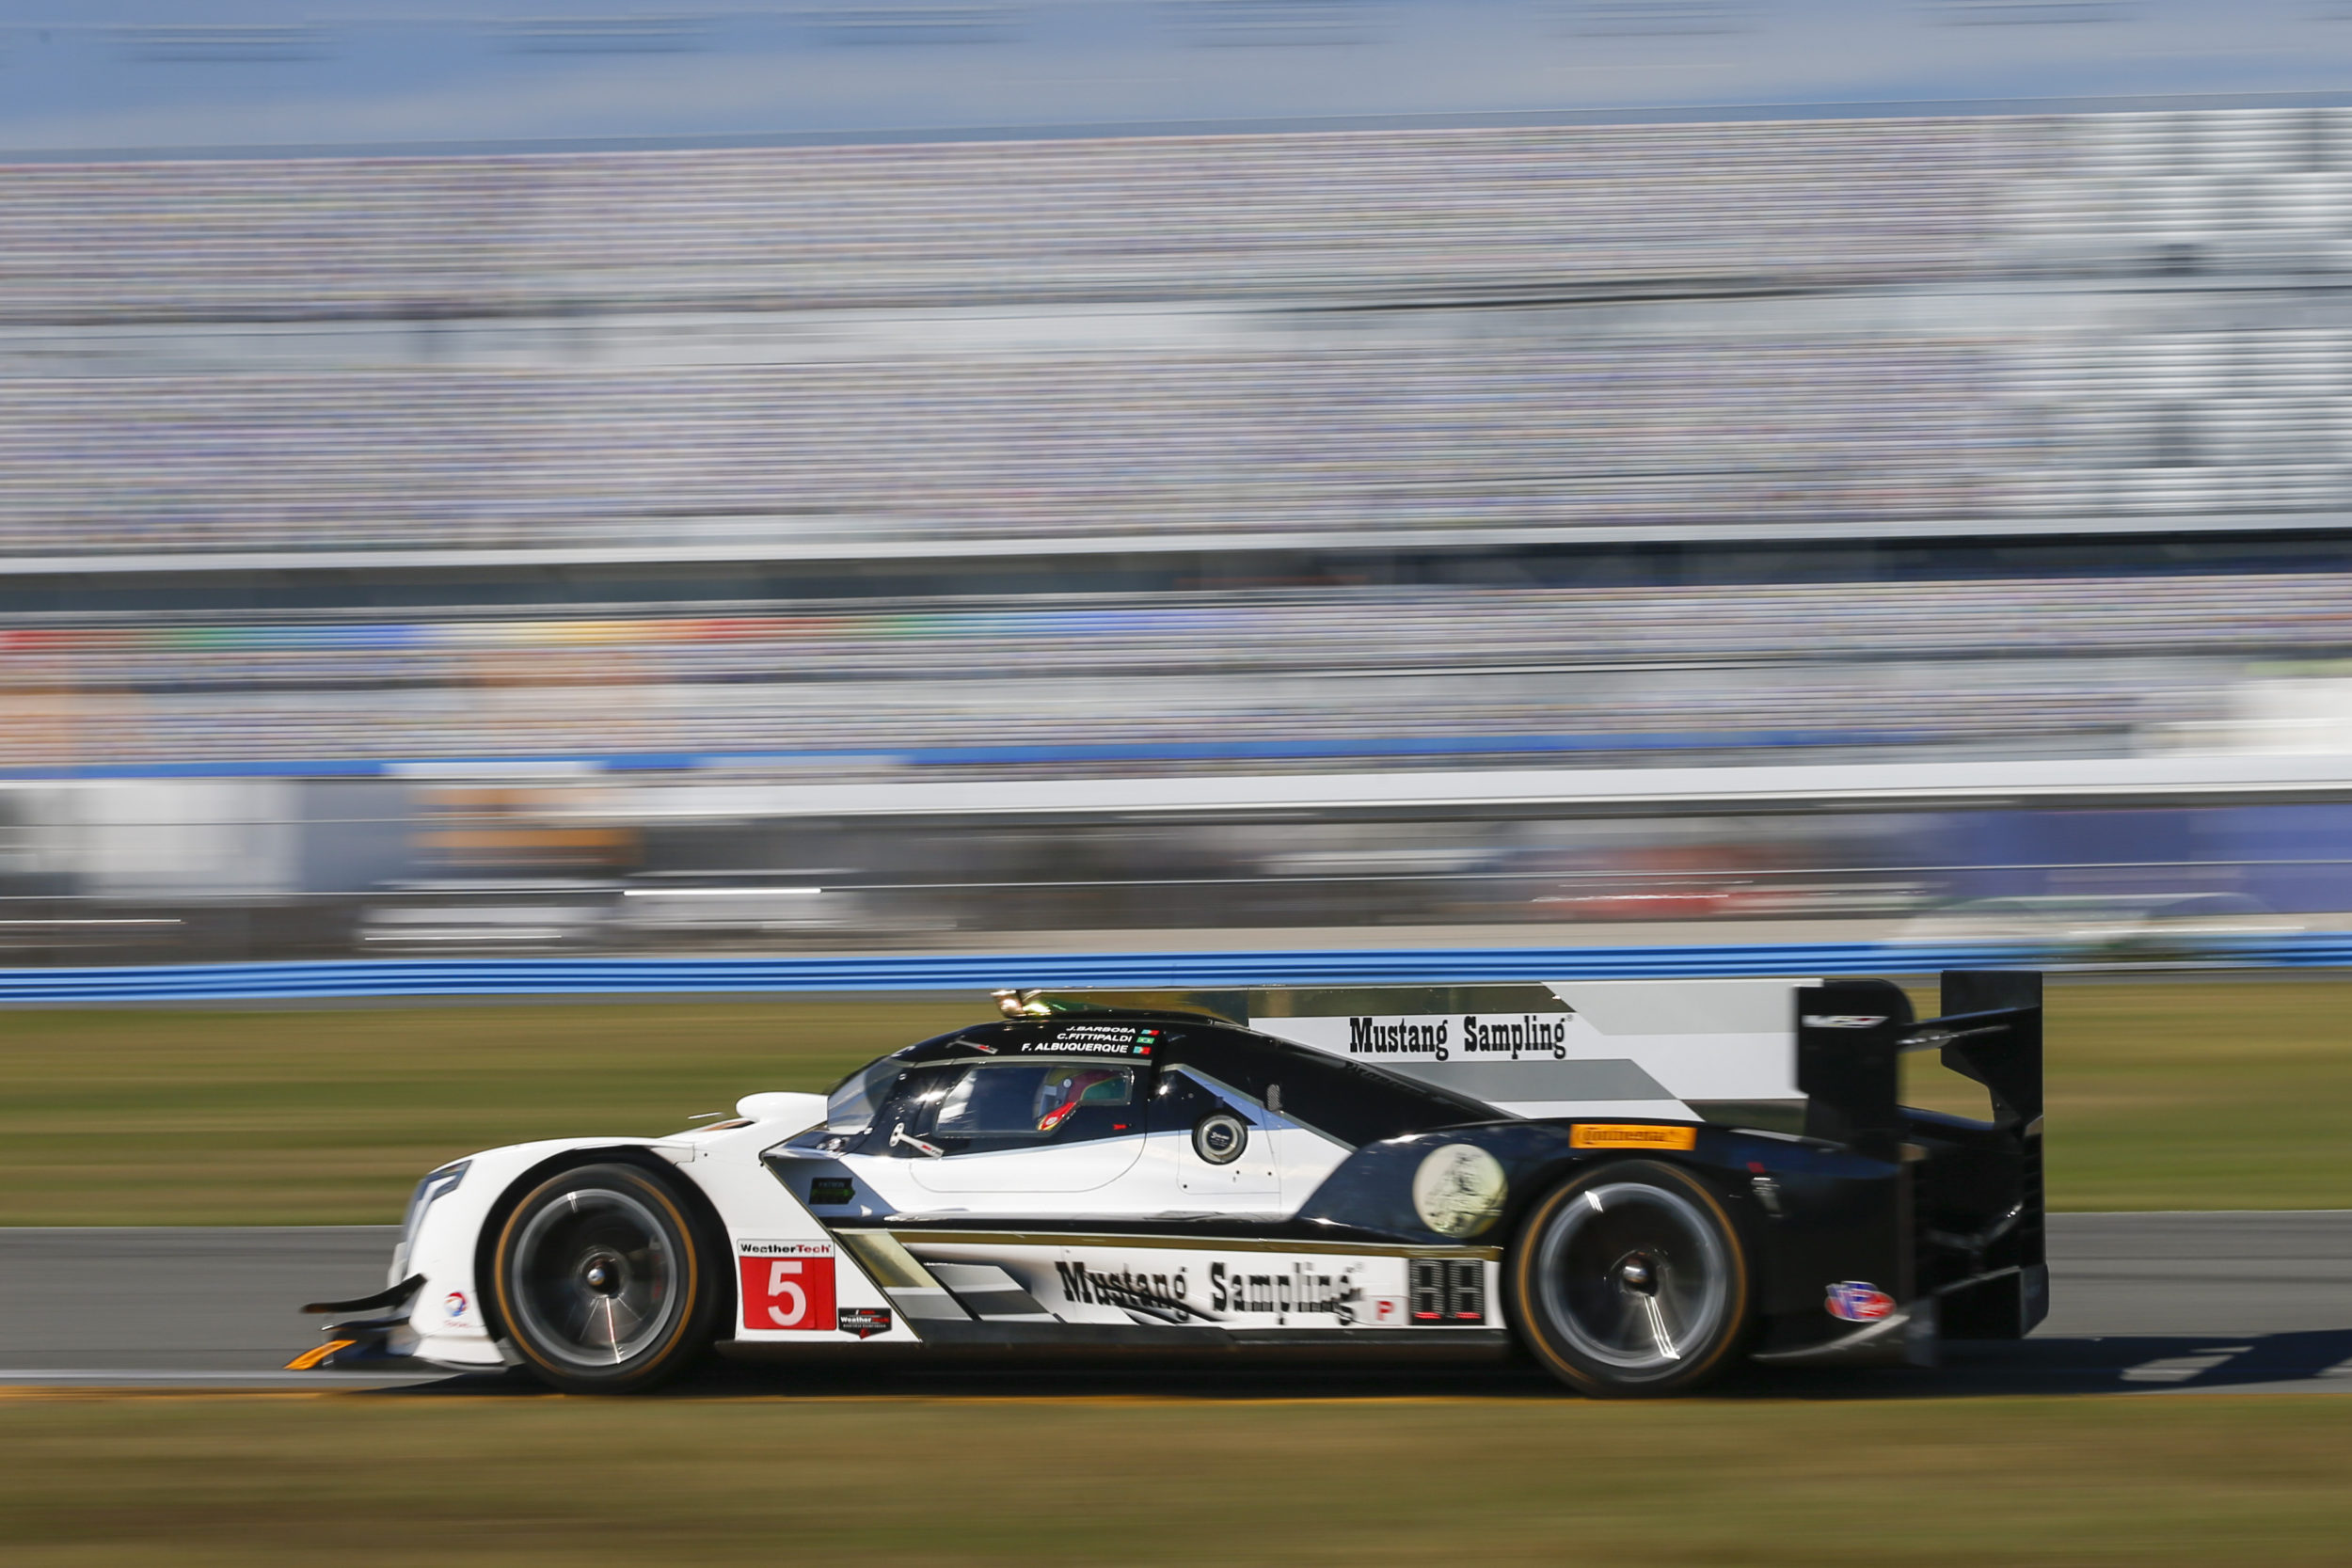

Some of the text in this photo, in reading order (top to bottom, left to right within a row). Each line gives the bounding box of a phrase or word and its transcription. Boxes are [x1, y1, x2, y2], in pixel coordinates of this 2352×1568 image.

[1021, 1042, 1129, 1053] F. ALBUQUERQUE
[1057, 1033, 1133, 1043] C.FITTIPALDI
[1349, 1015, 1566, 1061] Mustang Sampling
[739, 1243, 831, 1254] WeatherTech
[767, 1260, 807, 1327] 5
[1055, 1260, 1356, 1326] Mustang Sampling
[1376, 1300, 1394, 1322] P
